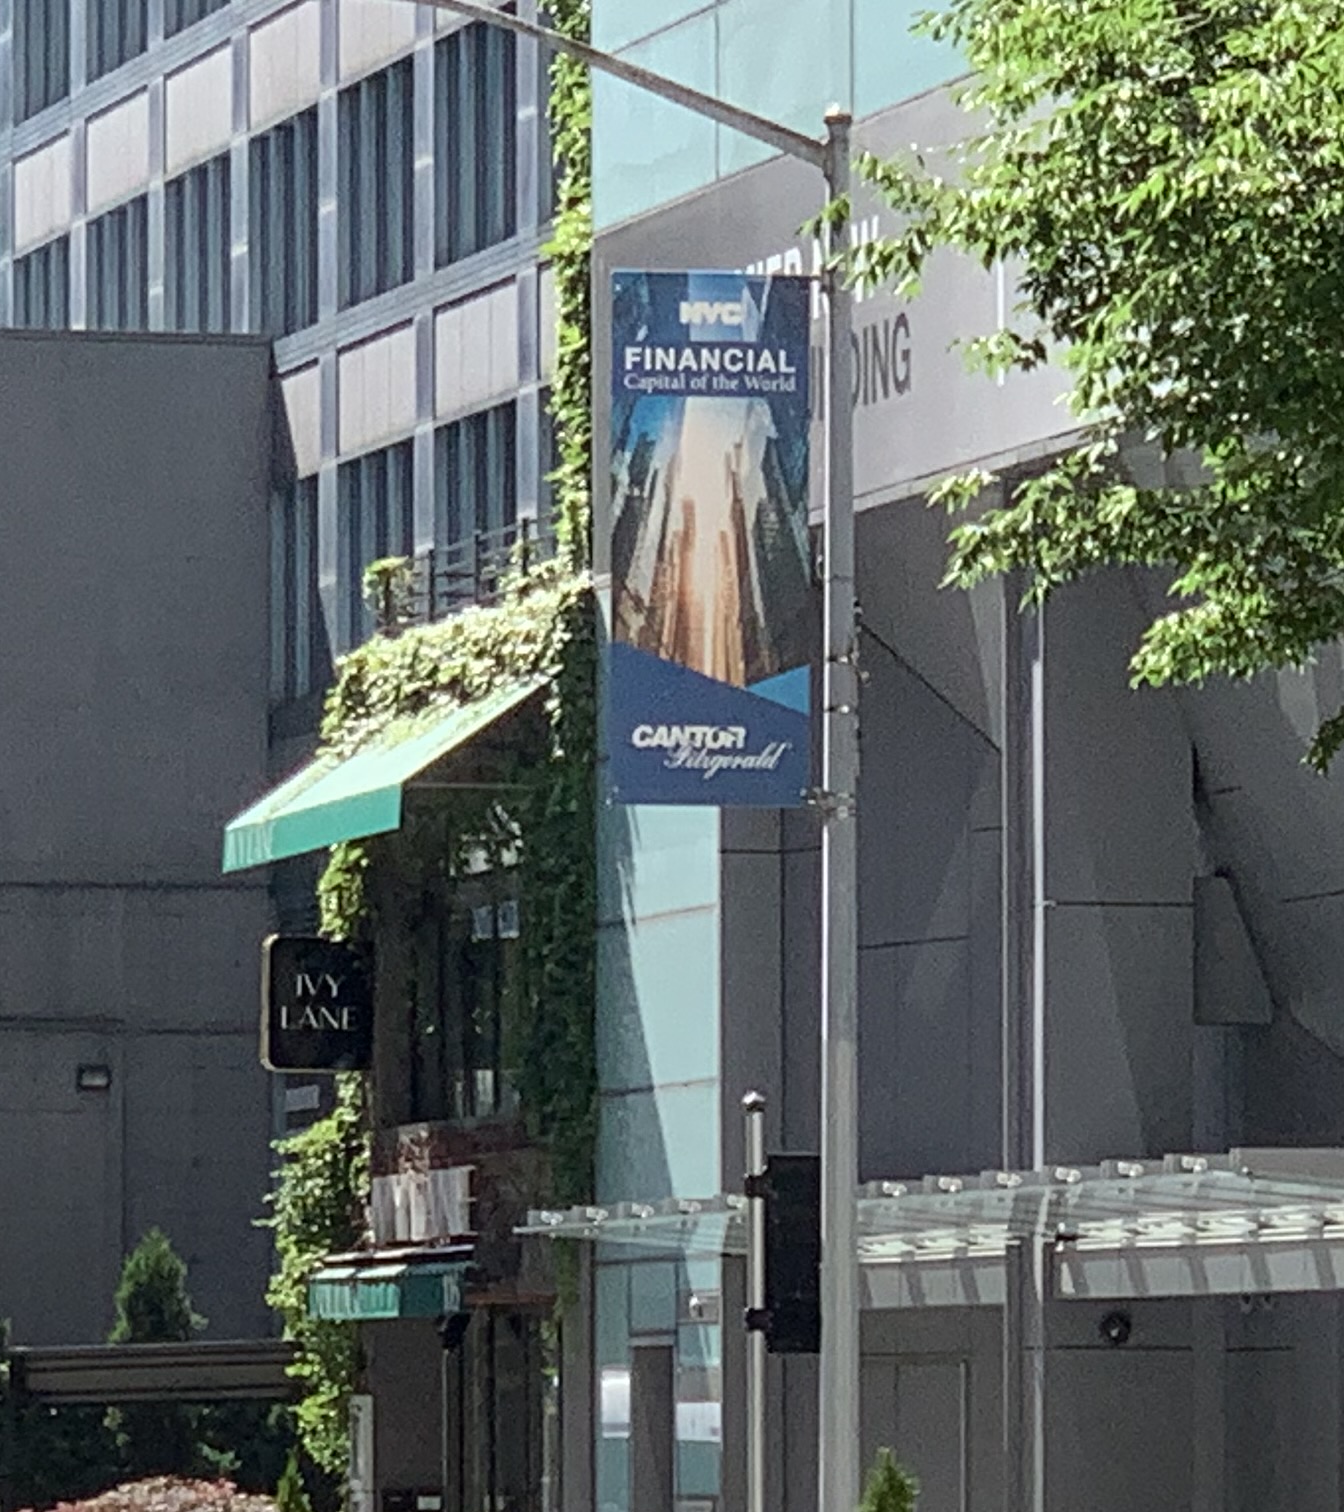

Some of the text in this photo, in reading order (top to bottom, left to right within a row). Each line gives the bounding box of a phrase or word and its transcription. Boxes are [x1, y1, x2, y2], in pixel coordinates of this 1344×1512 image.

[679, 301, 746, 325] NYC
[624, 346, 796, 374] FINANCIAL
[623, 373, 796, 394] Capital of the World
[631, 724, 747, 749] CANTOR
[663, 742, 785, 780] Fitzgerald
[296, 973, 346, 998] IVY
[280, 1005, 355, 1031] LANE
